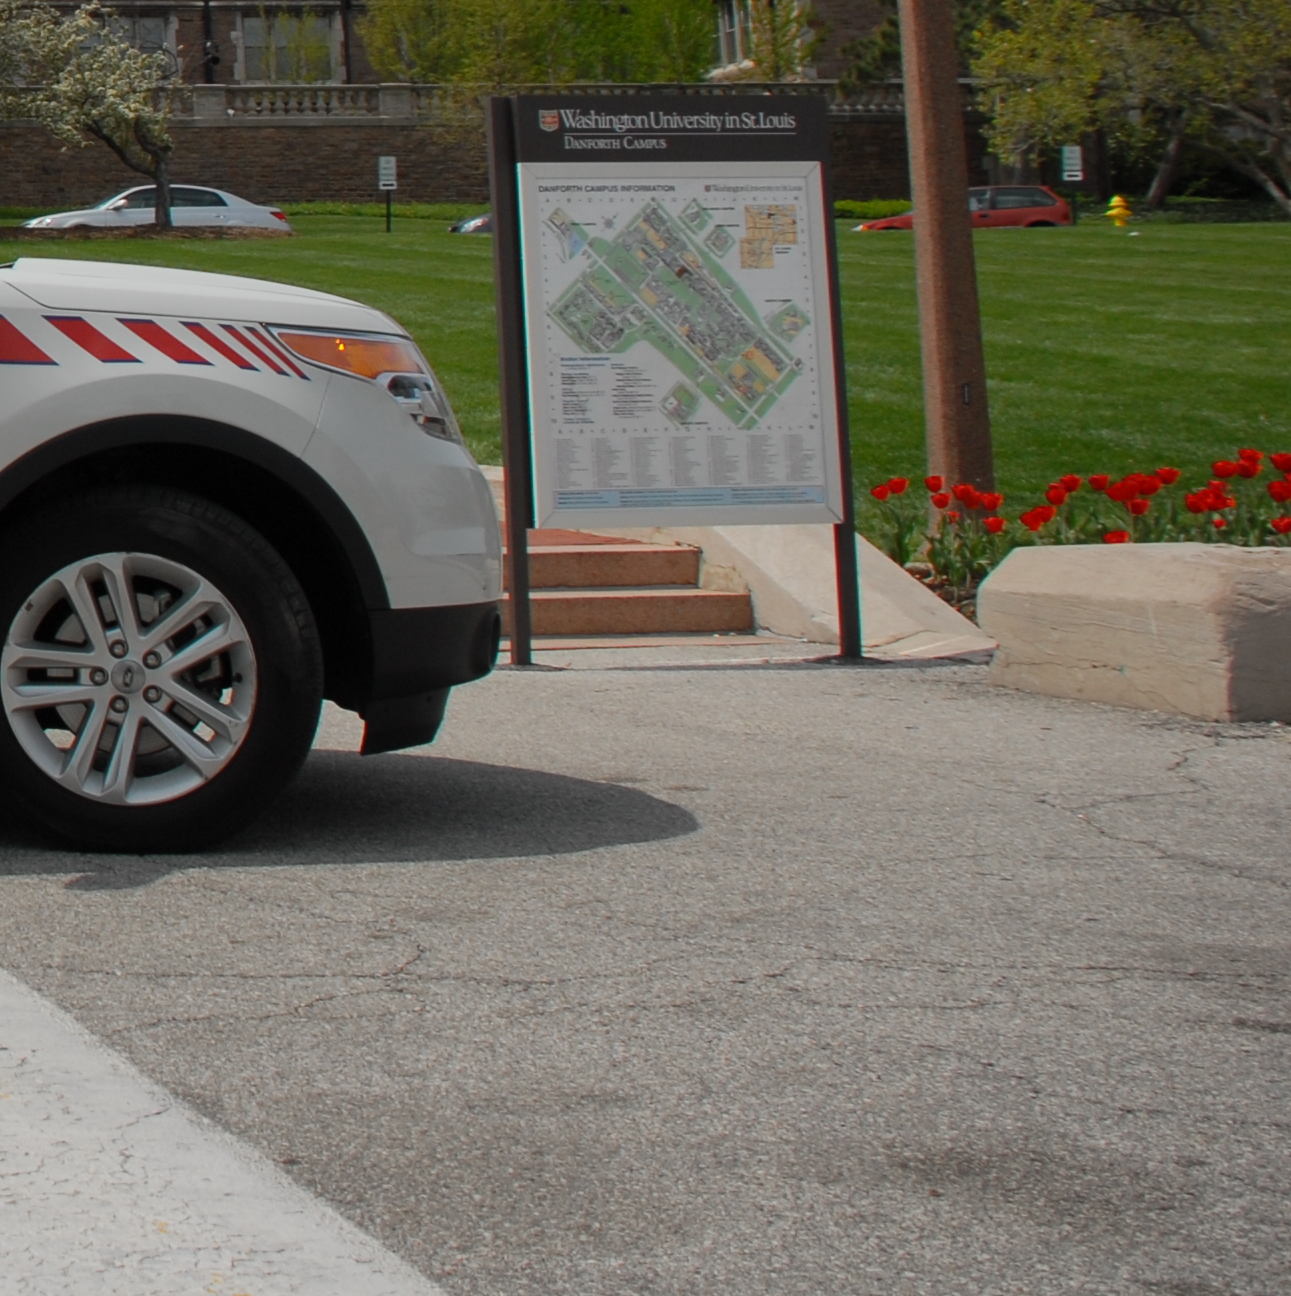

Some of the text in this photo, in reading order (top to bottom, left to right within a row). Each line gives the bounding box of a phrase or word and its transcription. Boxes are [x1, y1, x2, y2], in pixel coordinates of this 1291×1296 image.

[559, 109, 648, 132] Washington
[649, 111, 722, 131] University
[725, 112, 740, 128] in
[564, 136, 667, 149] DANFORTH CAMPUS
[538, 185, 676, 193] DANFORTH CAMPUS INFORMATION
